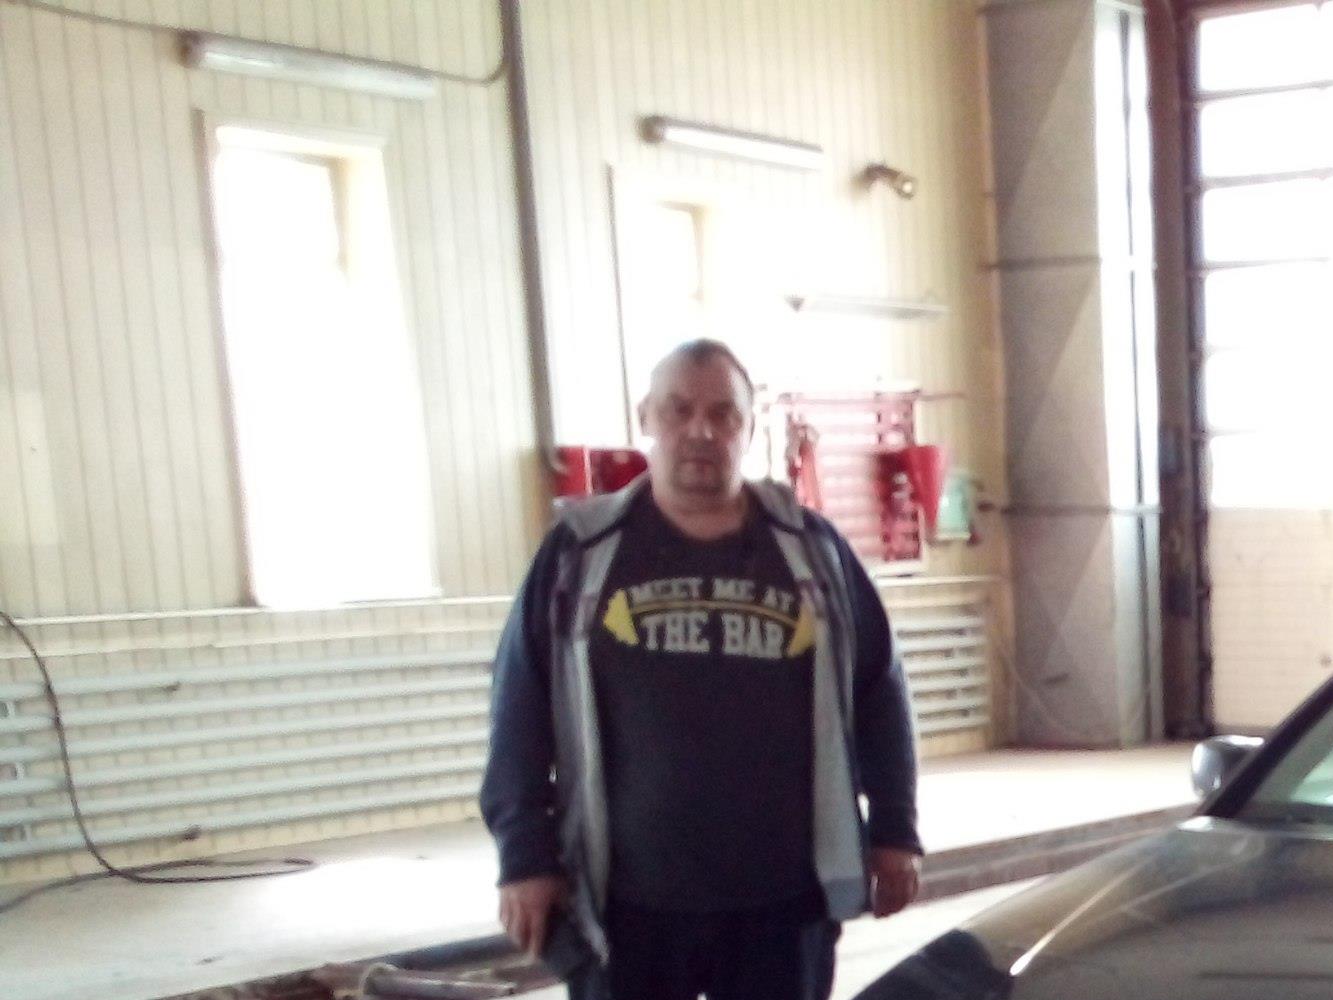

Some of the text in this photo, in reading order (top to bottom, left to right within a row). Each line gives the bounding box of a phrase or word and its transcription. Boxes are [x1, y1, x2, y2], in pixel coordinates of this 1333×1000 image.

[628, 577, 794, 613] MEET ME AT
[640, 611, 784, 660] THE BAR
